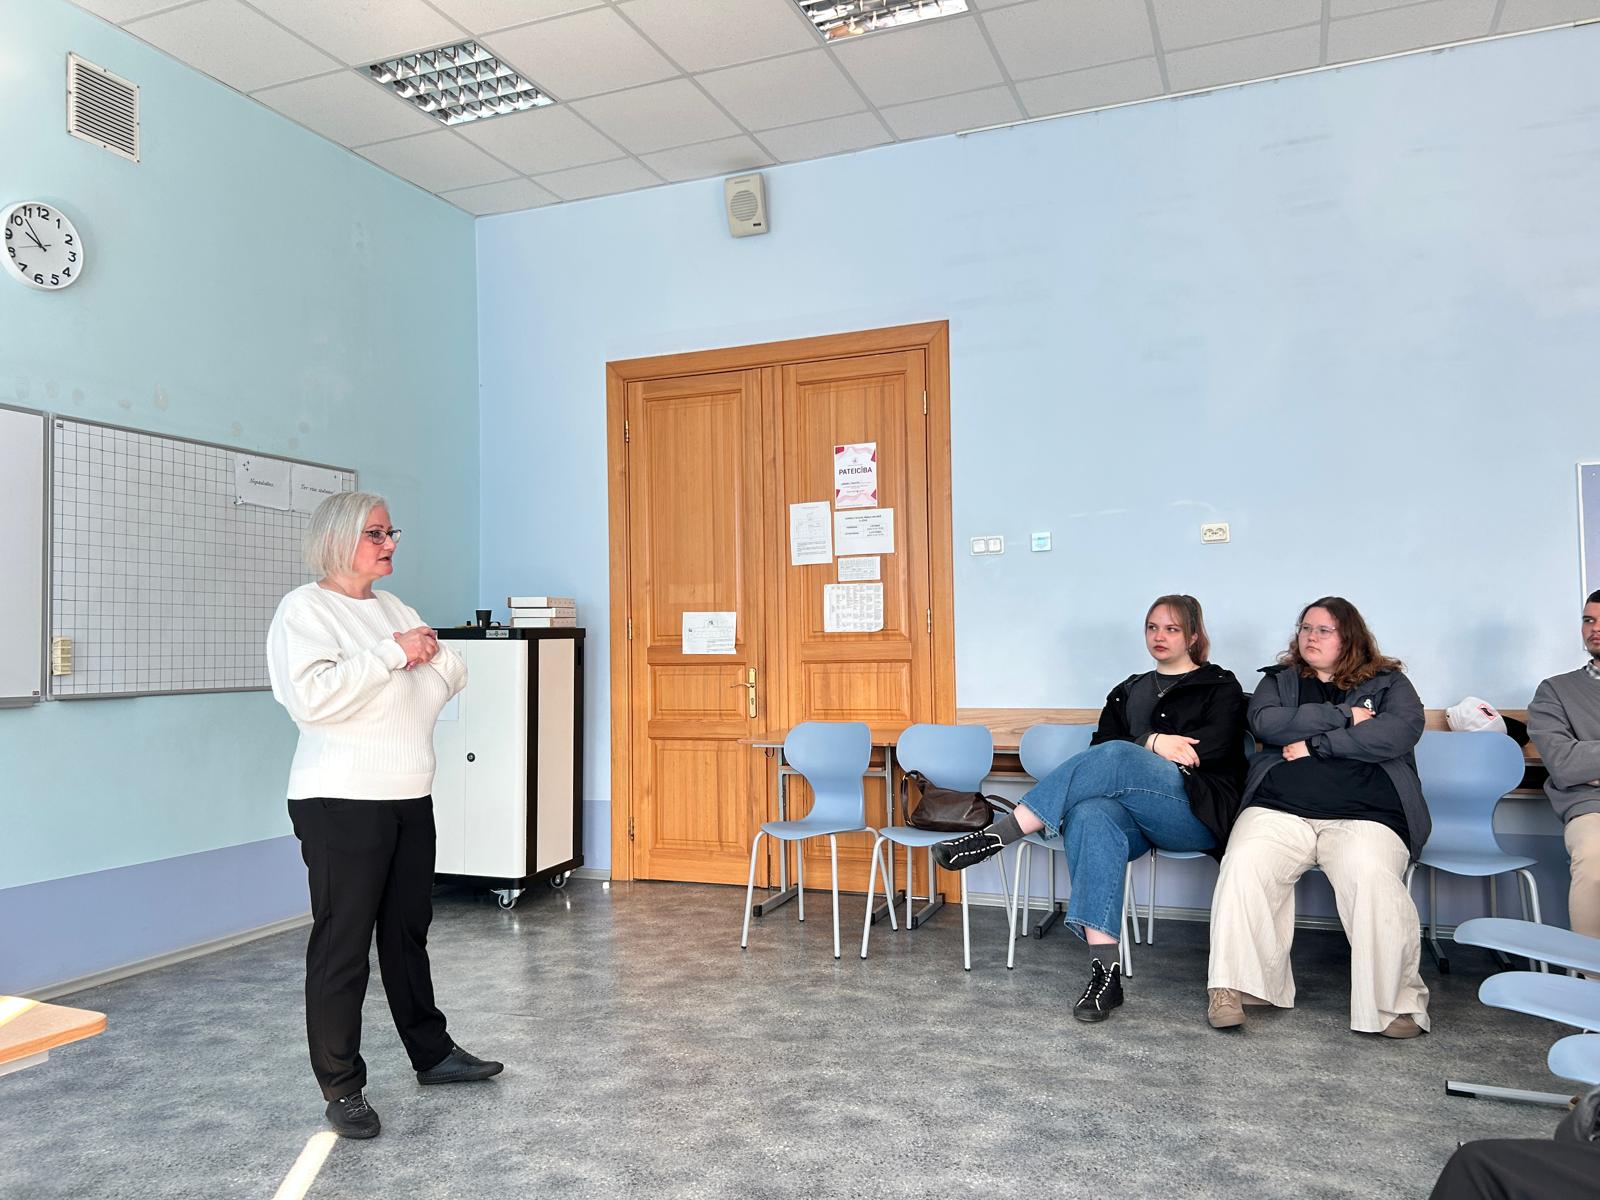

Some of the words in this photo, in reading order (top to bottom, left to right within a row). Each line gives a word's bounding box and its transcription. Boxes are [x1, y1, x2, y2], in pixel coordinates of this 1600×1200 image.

[22, 205, 32, 218] 11
[36, 206, 50, 221] 12
[10, 213, 23, 226] 10
[56, 218, 61, 229] 1
[5, 228, 13, 240] 9
[64, 233, 73, 246] 2
[8, 246, 16, 258] 8
[68, 251, 76, 262] 3
[18, 262, 28, 272] 7
[62, 267, 72, 278] 4
[34, 273, 44, 284] 6
[50, 274, 60, 285] 5
[838, 466, 873, 475] PATEICĪBA
